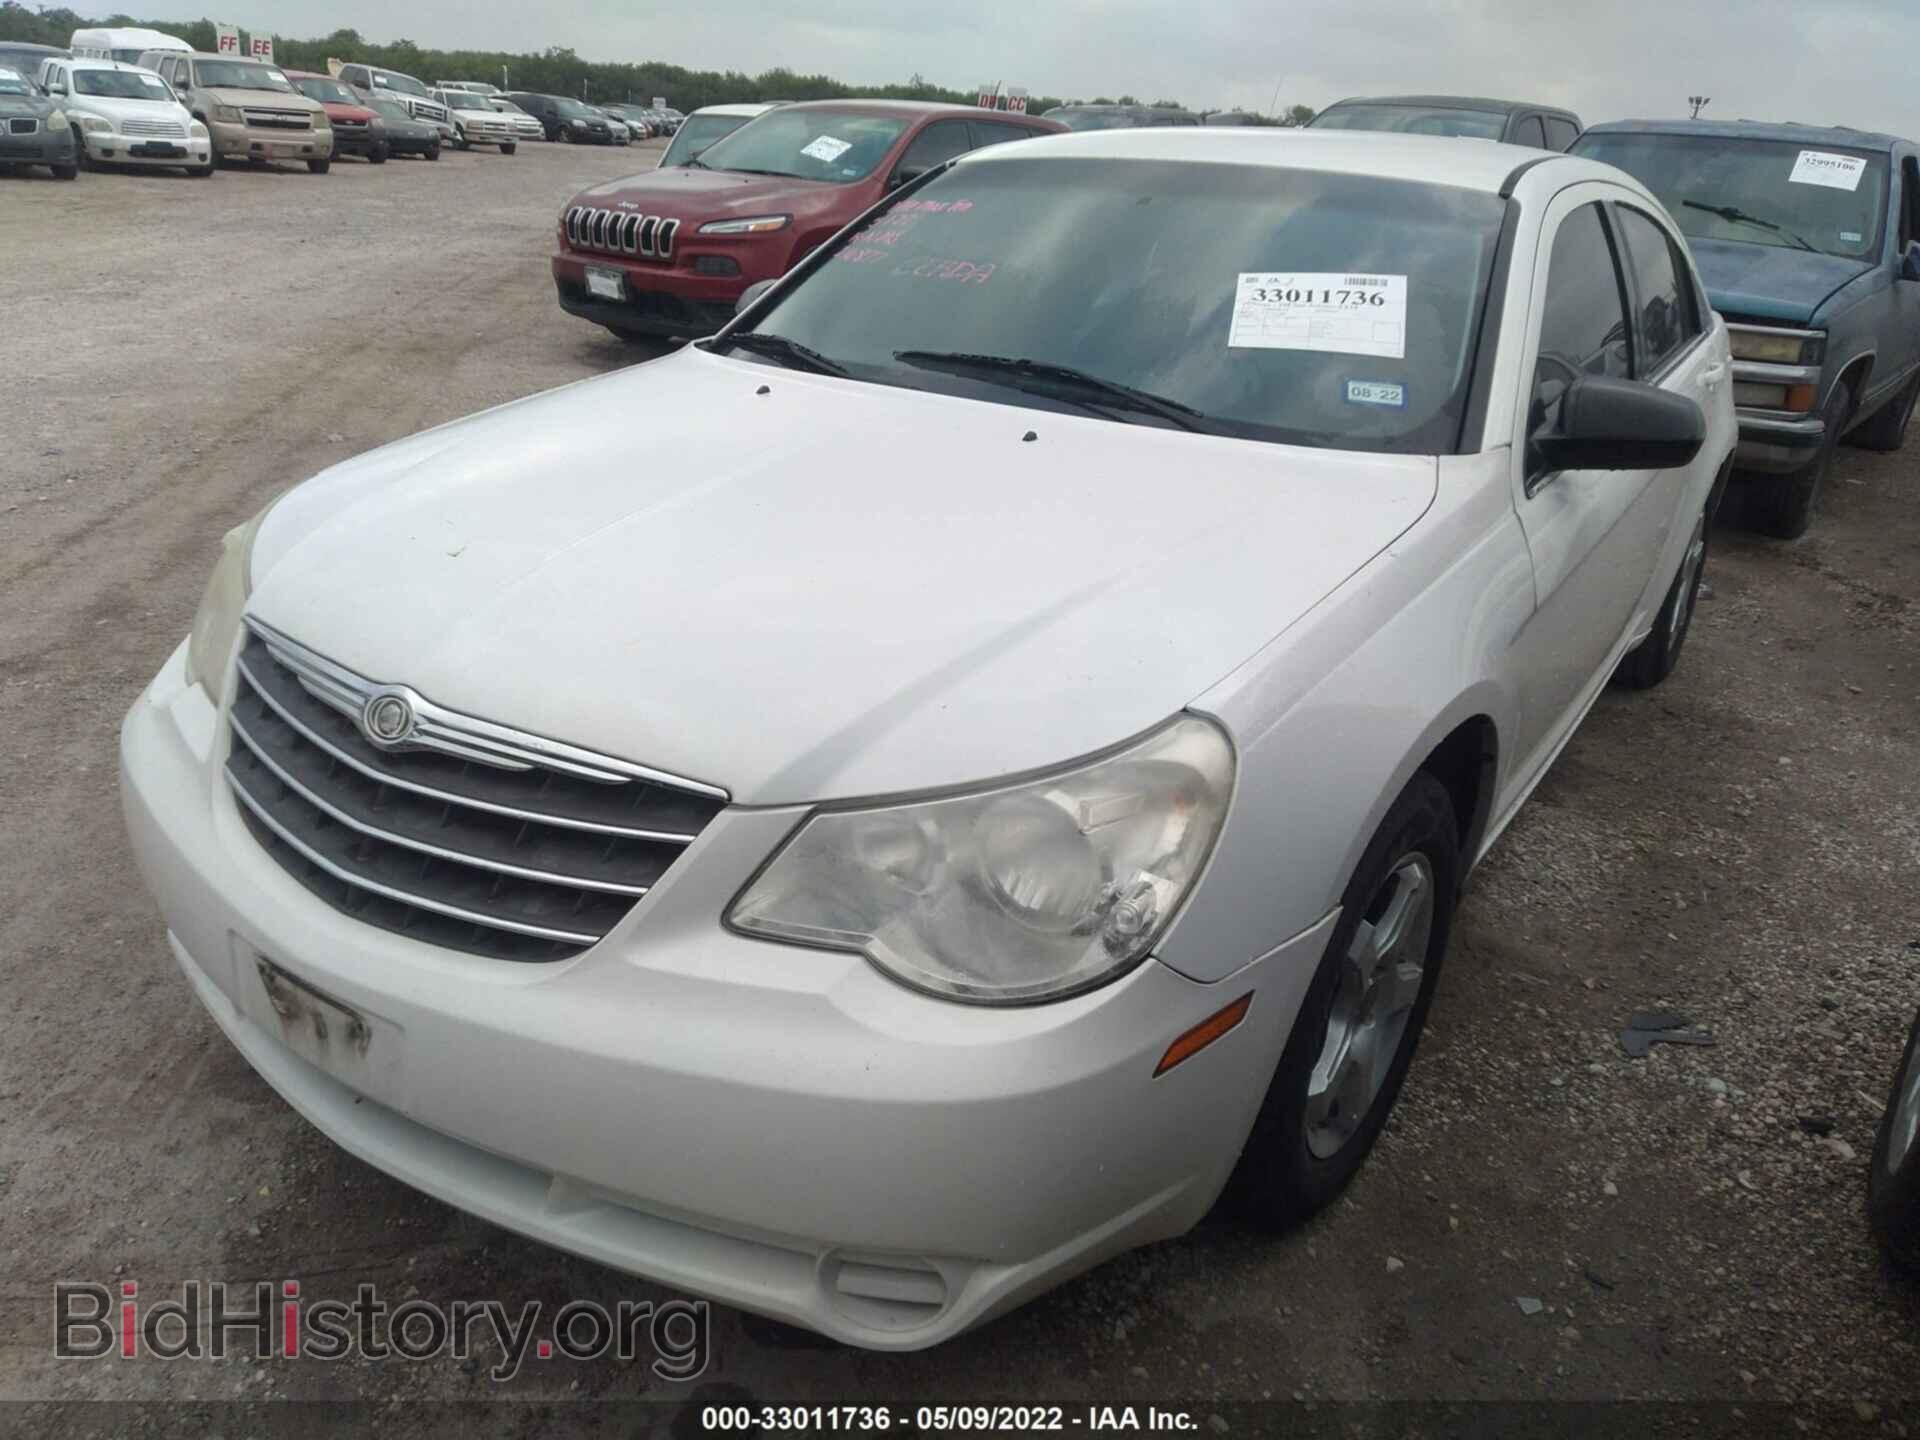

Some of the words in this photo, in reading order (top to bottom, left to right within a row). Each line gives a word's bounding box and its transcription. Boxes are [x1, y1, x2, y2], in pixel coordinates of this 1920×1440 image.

[220, 35, 237, 51] FF
[253, 39, 271, 55] EE
[1007, 96, 1025, 111] CC
[1251, 288, 1386, 307] 33011736
